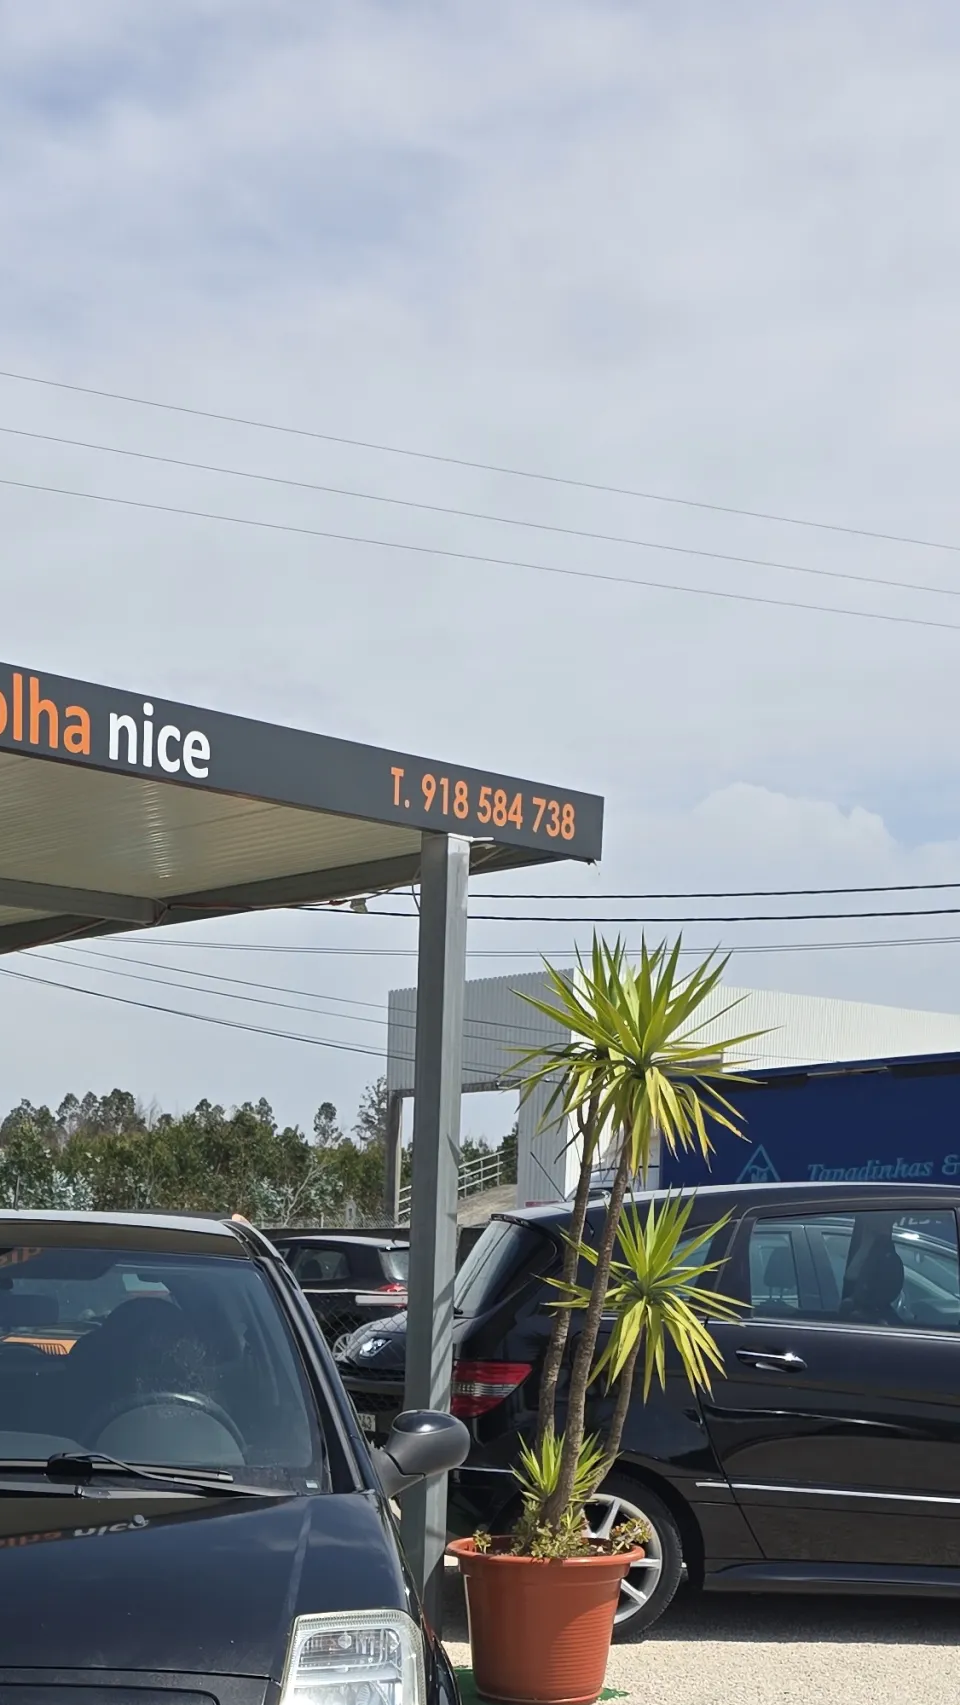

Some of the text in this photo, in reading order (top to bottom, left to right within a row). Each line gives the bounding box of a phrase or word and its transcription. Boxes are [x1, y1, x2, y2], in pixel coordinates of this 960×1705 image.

[108, 702, 211, 778] nice
[391, 766, 575, 840] T. 918 584 738
